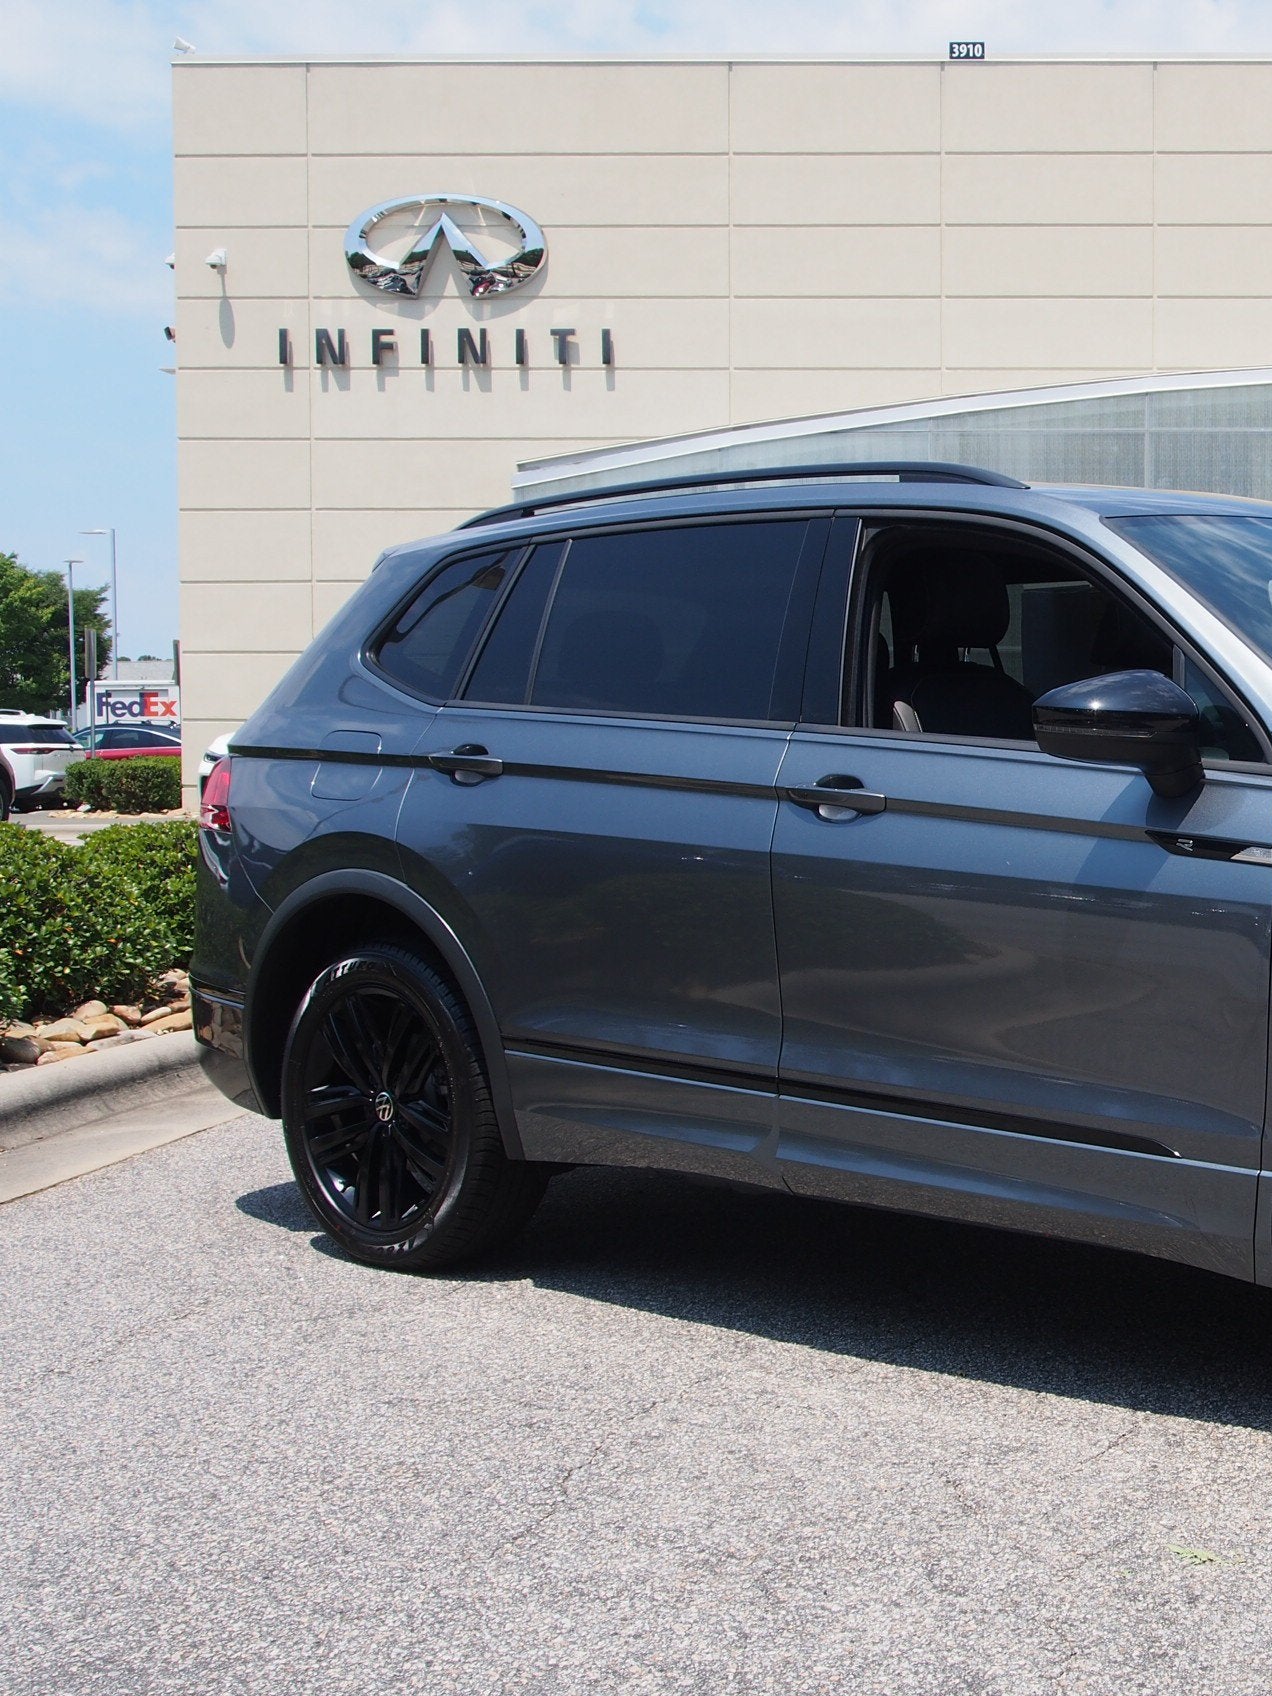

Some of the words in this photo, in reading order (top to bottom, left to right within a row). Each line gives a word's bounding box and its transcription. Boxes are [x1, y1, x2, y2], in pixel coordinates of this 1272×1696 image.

[951, 43, 983, 57] 3910
[278, 328, 612, 365] INFINITI
[96, 692, 177, 717] FedEx
